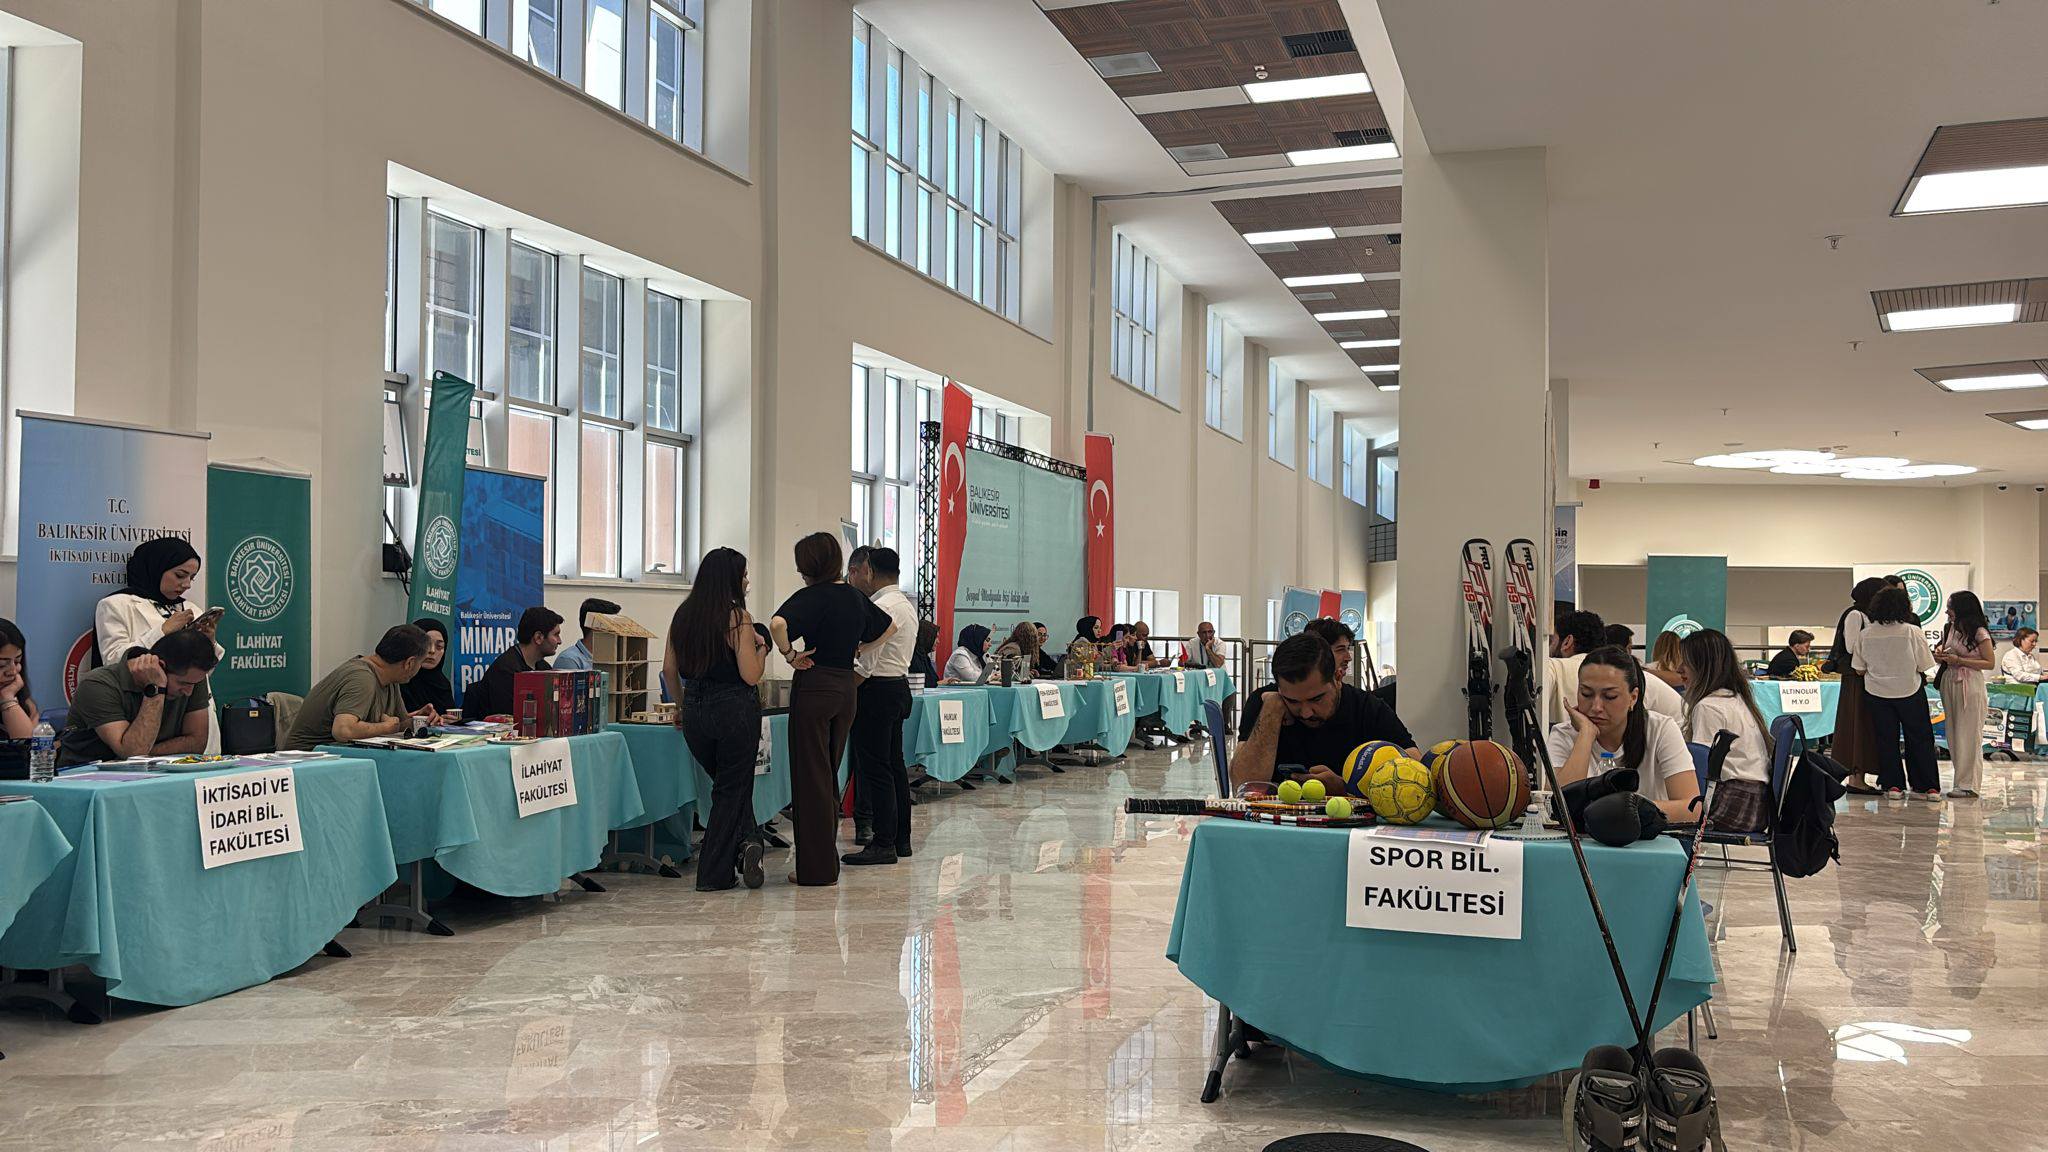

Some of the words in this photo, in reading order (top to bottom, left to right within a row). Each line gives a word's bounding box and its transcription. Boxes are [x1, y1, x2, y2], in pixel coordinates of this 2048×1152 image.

[108, 498, 130, 514] T.C.
[970, 498, 1010, 520] ÜNİVERSİTESİ
[38, 522, 107, 541] BALIKESİR
[49, 547, 93, 562] İKTİSADİ
[95, 551, 110, 562] VE
[1479, 546, 1491, 570] PRO
[1522, 547, 1534, 571] PRO
[236, 633, 283, 649] İLAHİYAT
[231, 652, 287, 669] FAKÜLTESİ
[521, 759, 563, 779] İLAHİYAT
[203, 777, 267, 804] İKTİSADİ
[270, 777, 289, 794] VE
[519, 778, 568, 804] FAKÜLTESİ
[211, 804, 252, 829] İDARİ
[256, 802, 284, 822] BİL.
[210, 823, 290, 855] FAKÜLTESİ
[1369, 846, 1444, 870] SPOR
[1451, 847, 1500, 874] BİL.
[1364, 885, 1505, 916] FAKÜLTESİ
